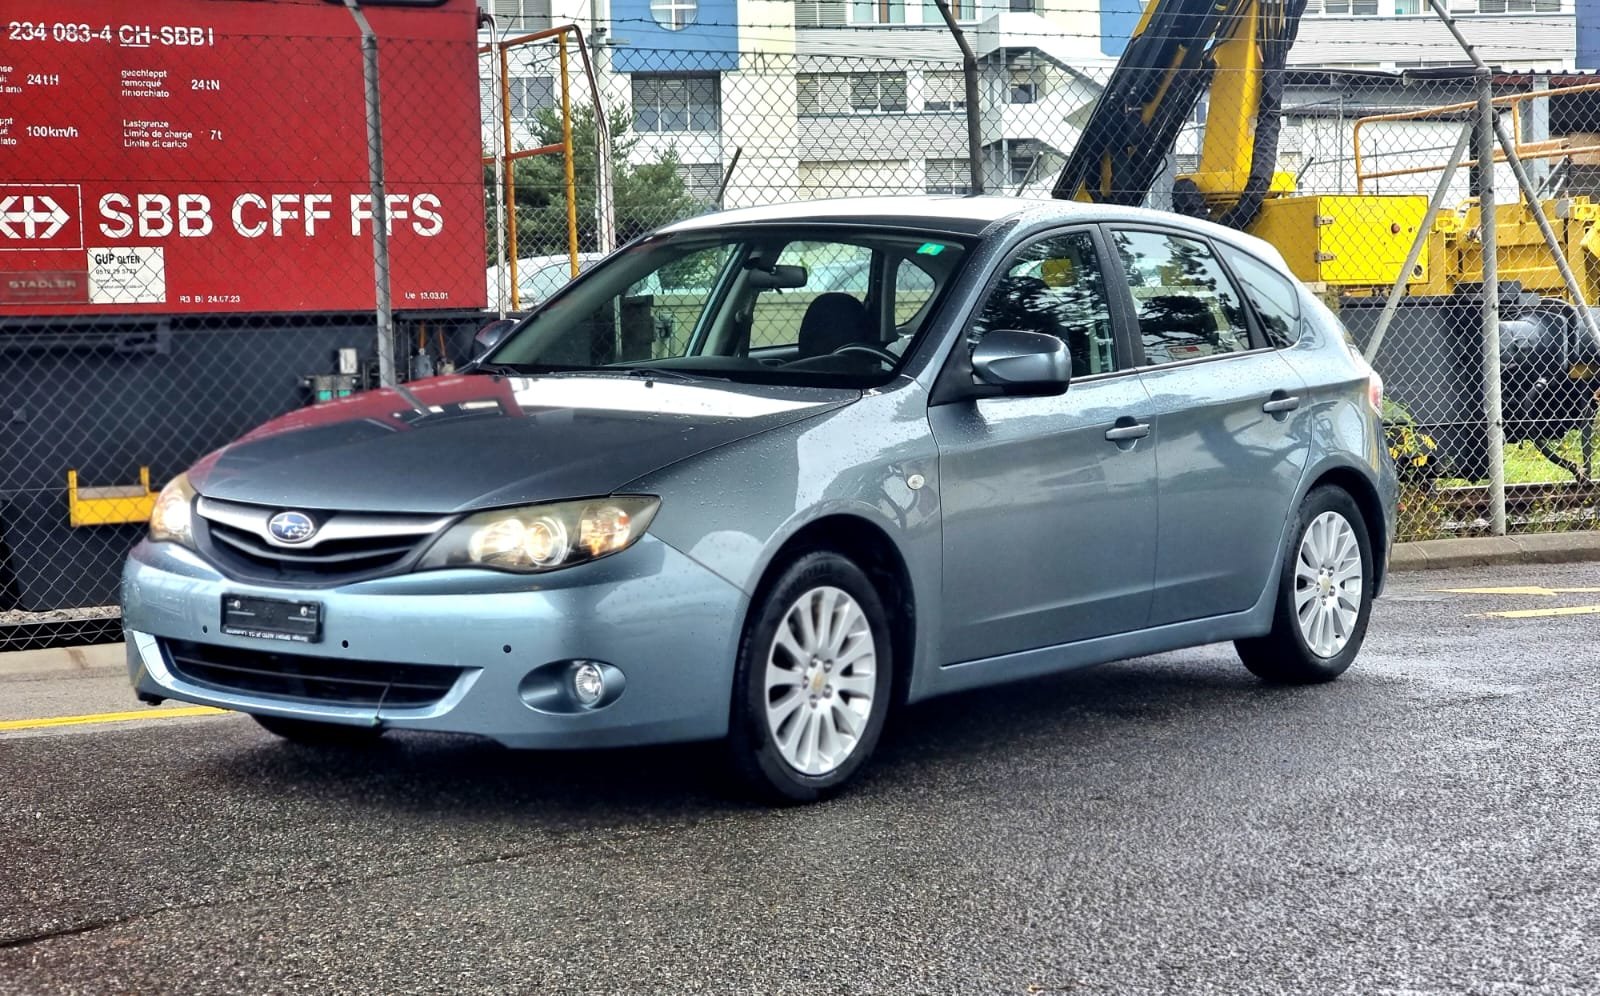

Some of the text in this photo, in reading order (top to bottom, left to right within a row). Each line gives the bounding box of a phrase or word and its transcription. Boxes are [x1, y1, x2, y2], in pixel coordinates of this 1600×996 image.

[9, 21, 47, 41] 234
[53, 23, 112, 43] 083-4
[121, 80, 162, 88] remorqué
[121, 89, 170, 98] rimorchiato
[123, 120, 169, 130] Lastgrenze
[123, 129, 193, 140] Limite de charge
[124, 139, 150, 148] Limite
[152, 140, 161, 148] di
[98, 192, 443, 239] SBB CFF FFS
[95, 253, 140, 265] GUP OLTEN
[8, 280, 77, 289] STADLER
